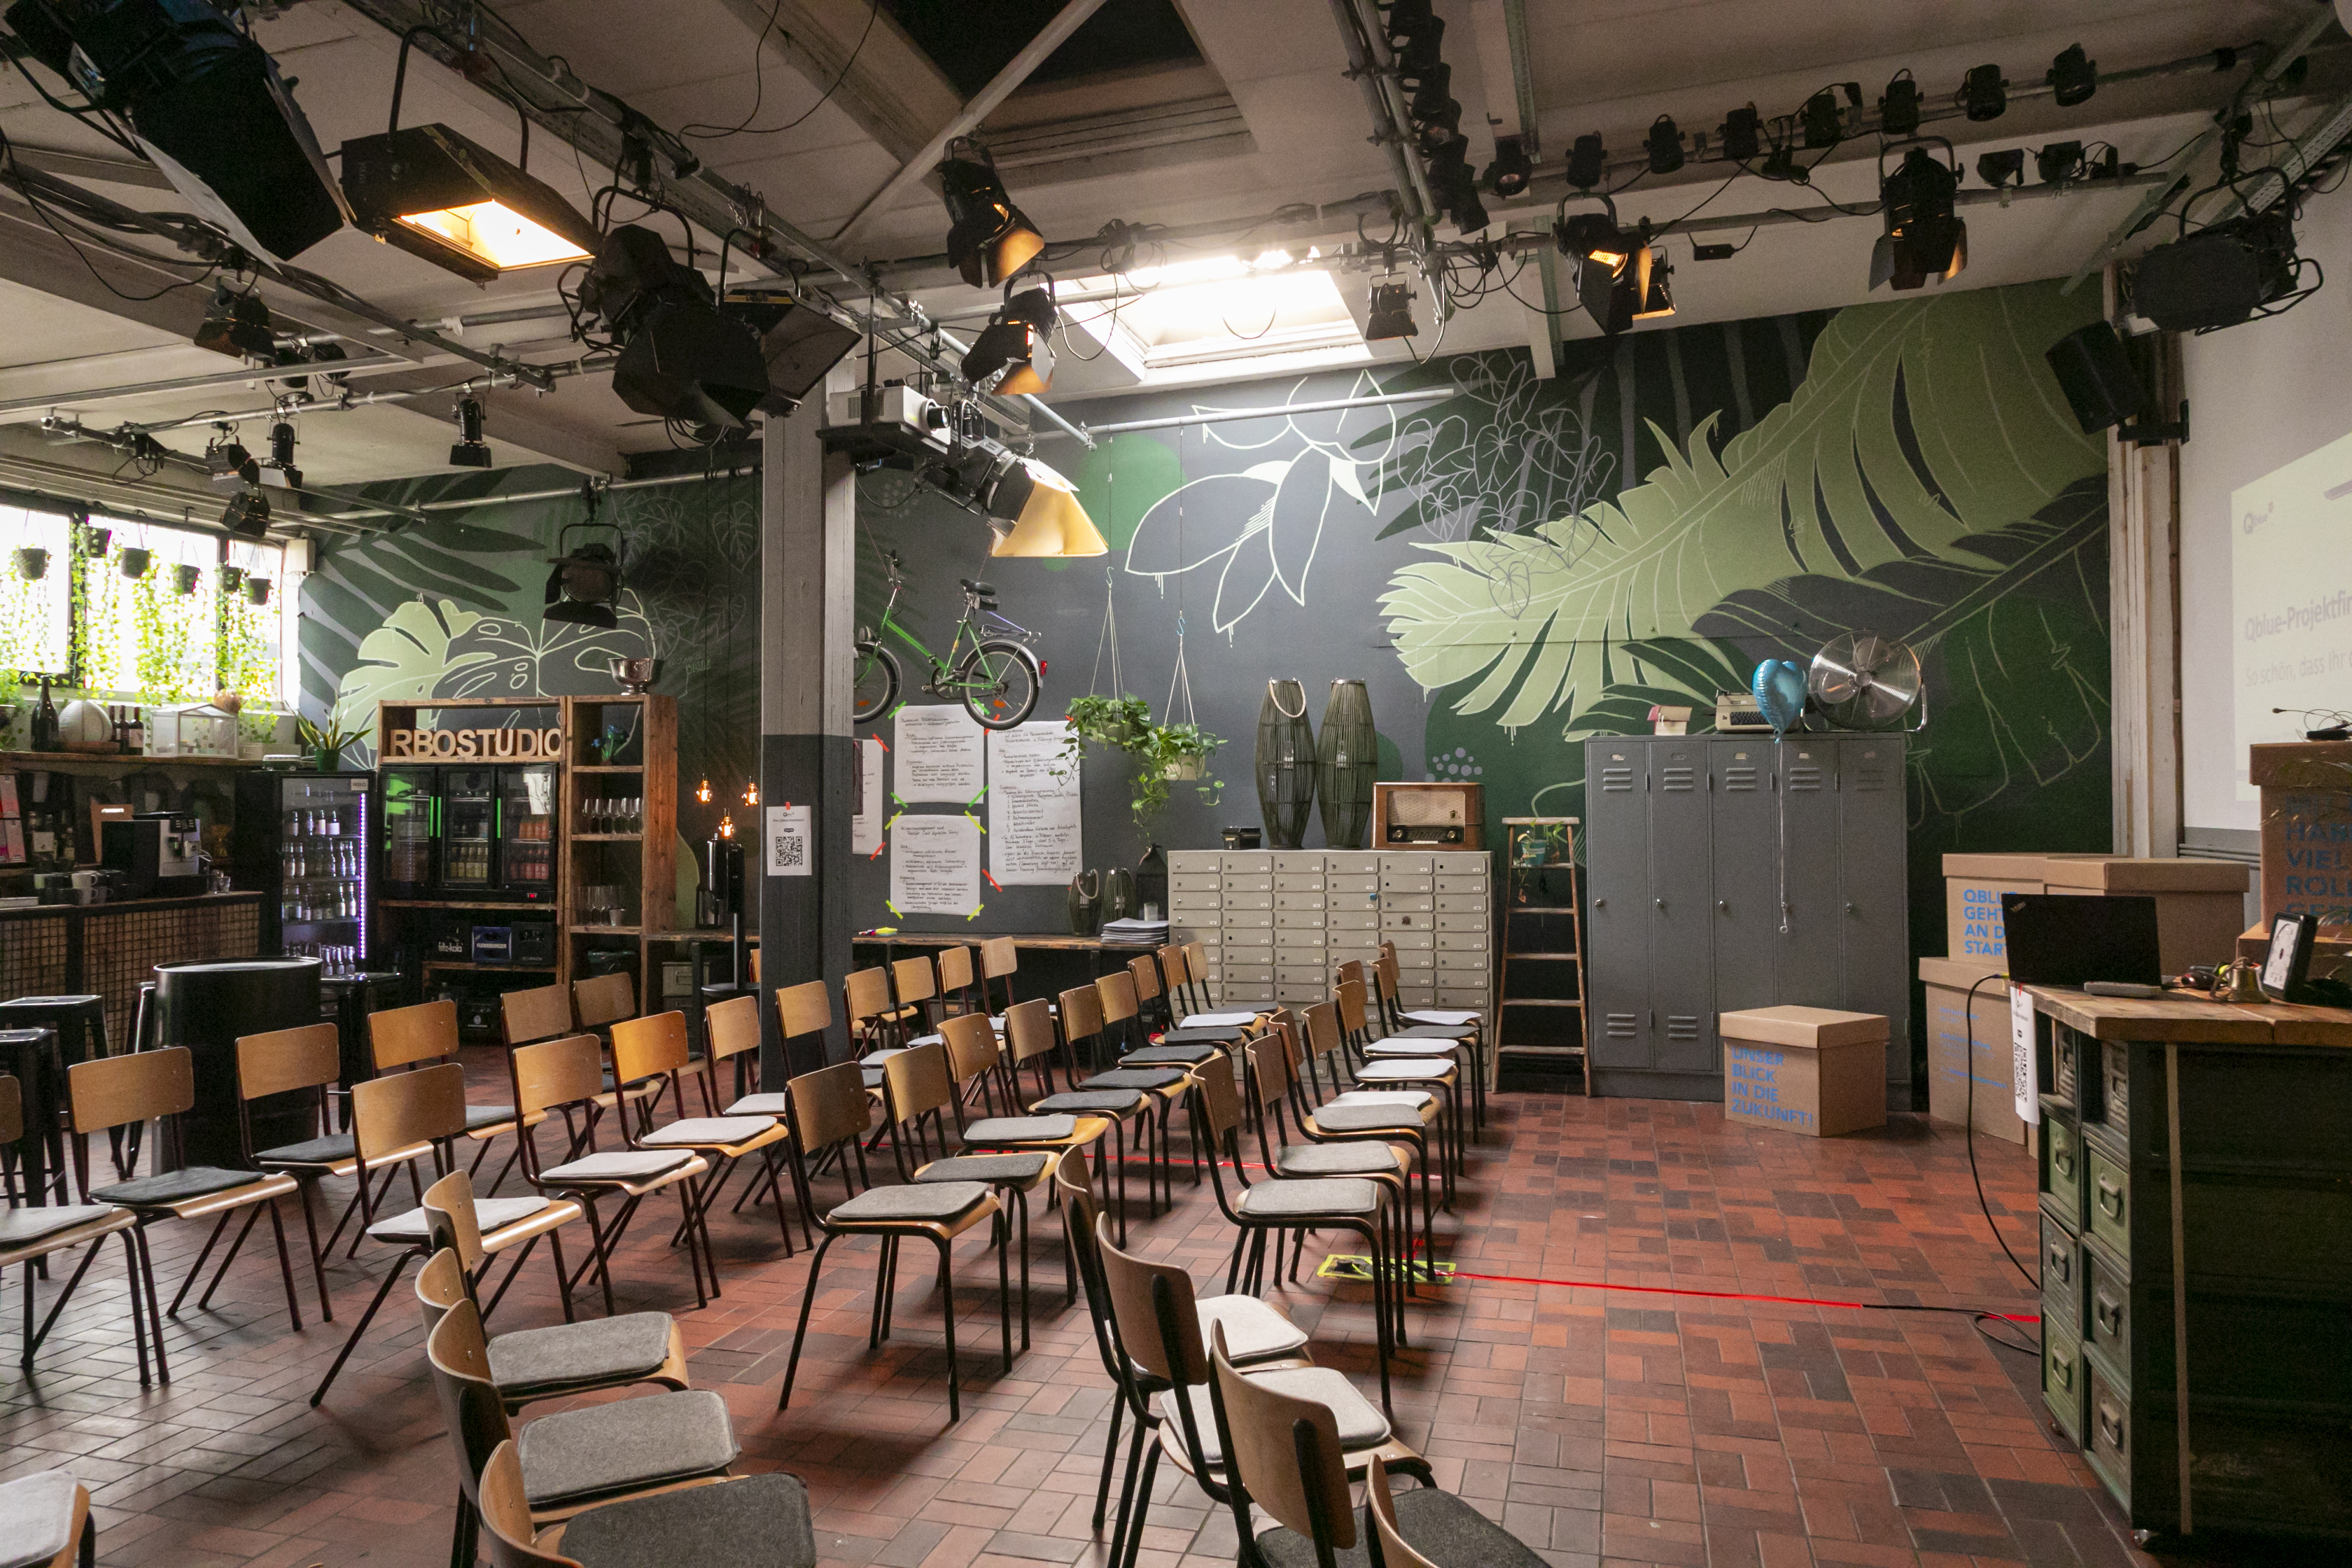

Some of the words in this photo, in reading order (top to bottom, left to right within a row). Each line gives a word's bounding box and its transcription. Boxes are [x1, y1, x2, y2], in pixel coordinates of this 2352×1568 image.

[2300, 656, 2325, 677] dass
[390, 728, 561, 757] RBOSTUDIO
[2286, 822, 2352, 842] HAB
[1963, 889, 2017, 904] QBLU
[1964, 924, 1988, 938] AN
[1964, 940, 2007, 956] STAR
[1732, 1046, 1784, 1065] UNSER
[1732, 1063, 1775, 1083] BLICK
[1732, 1082, 1748, 1096] IN
[1753, 1084, 1779, 1102] DIE
[1731, 1098, 1813, 1127] ZUKUNFT!
